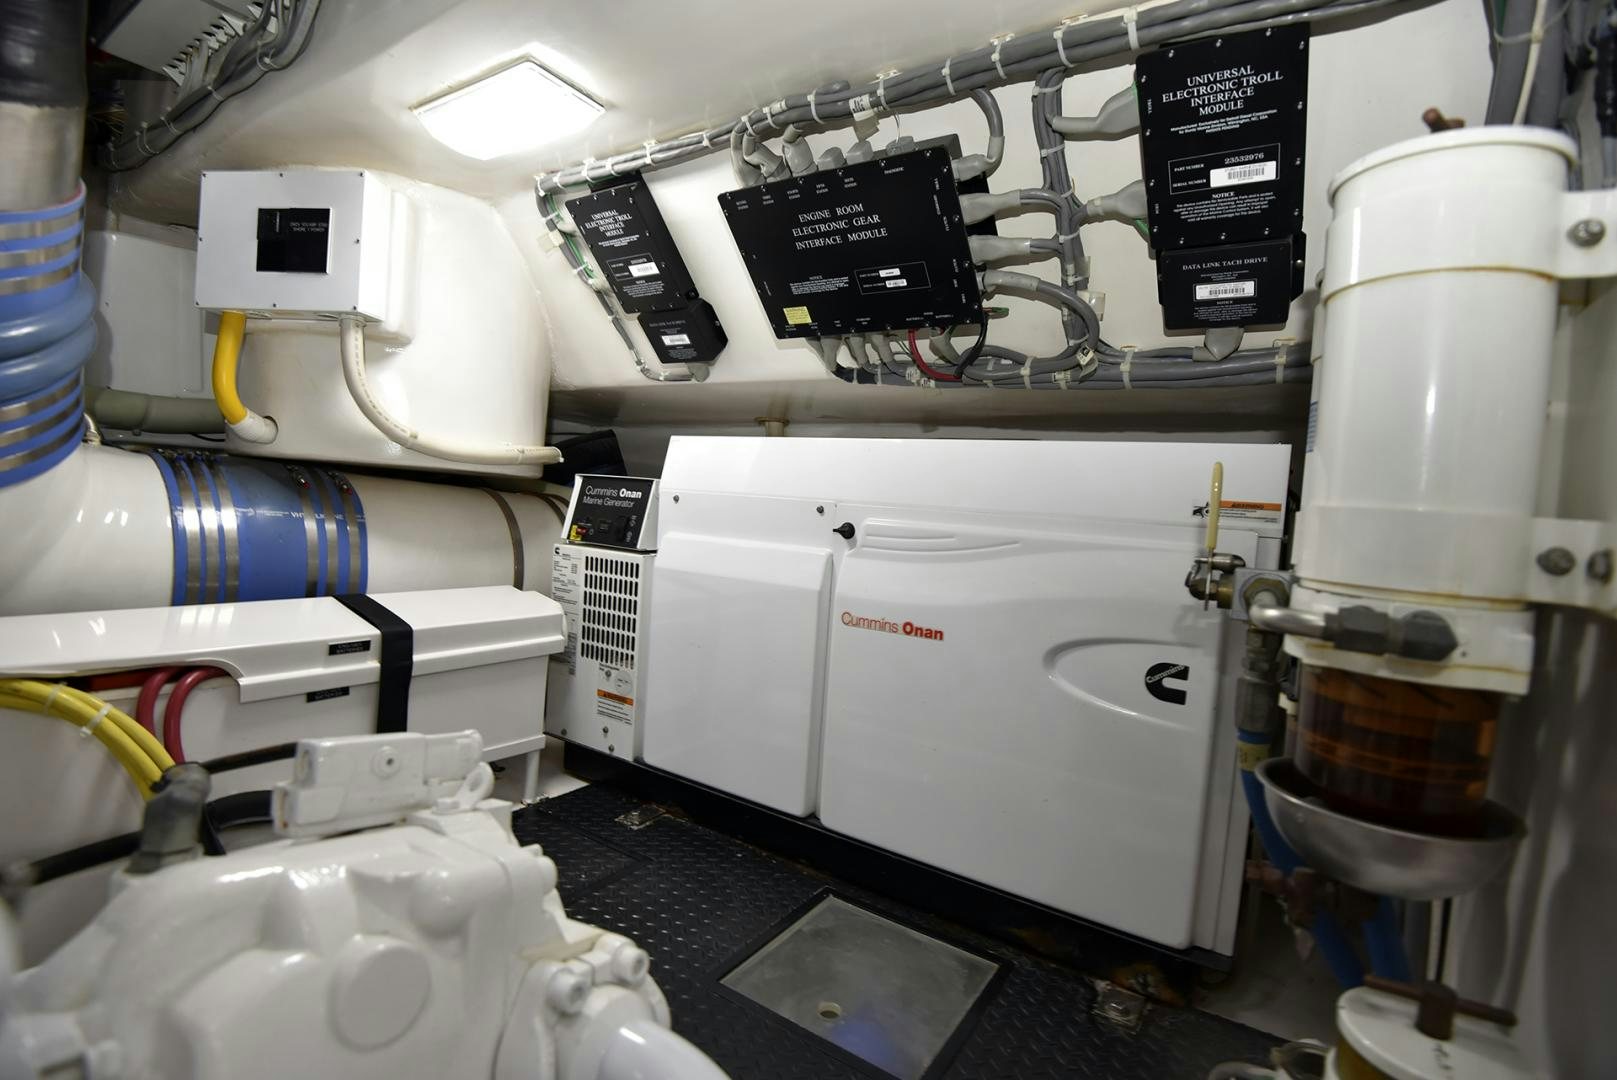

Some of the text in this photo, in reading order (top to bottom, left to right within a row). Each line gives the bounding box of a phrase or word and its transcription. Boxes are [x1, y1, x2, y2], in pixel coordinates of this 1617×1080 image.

[1187, 65, 1254, 86] UNIVERSAL
[1162, 70, 1284, 103] ELECTRONIC TROLL
[1191, 86, 1254, 108] INTERFACE
[1199, 100, 1244, 116] MODULE
[584, 213, 632, 230] ELECTRONIC TROLL
[591, 209, 619, 221] UNIVERSAL
[798, 203, 864, 223] ENGINE ROOM
[598, 222, 625, 232] INTERFACE
[605, 228, 624, 238] MODULE
[792, 214, 880, 237] ELECTRONIC GEAR
[795, 228, 888, 250] INTERFACE MODULE
[1182, 256, 1268, 271] DATA LINK TACH DRIVE
[585, 485, 642, 499] Cummins Onan
[582, 496, 636, 508] Marine Generator
[841, 611, 944, 641] Cummins Onan
